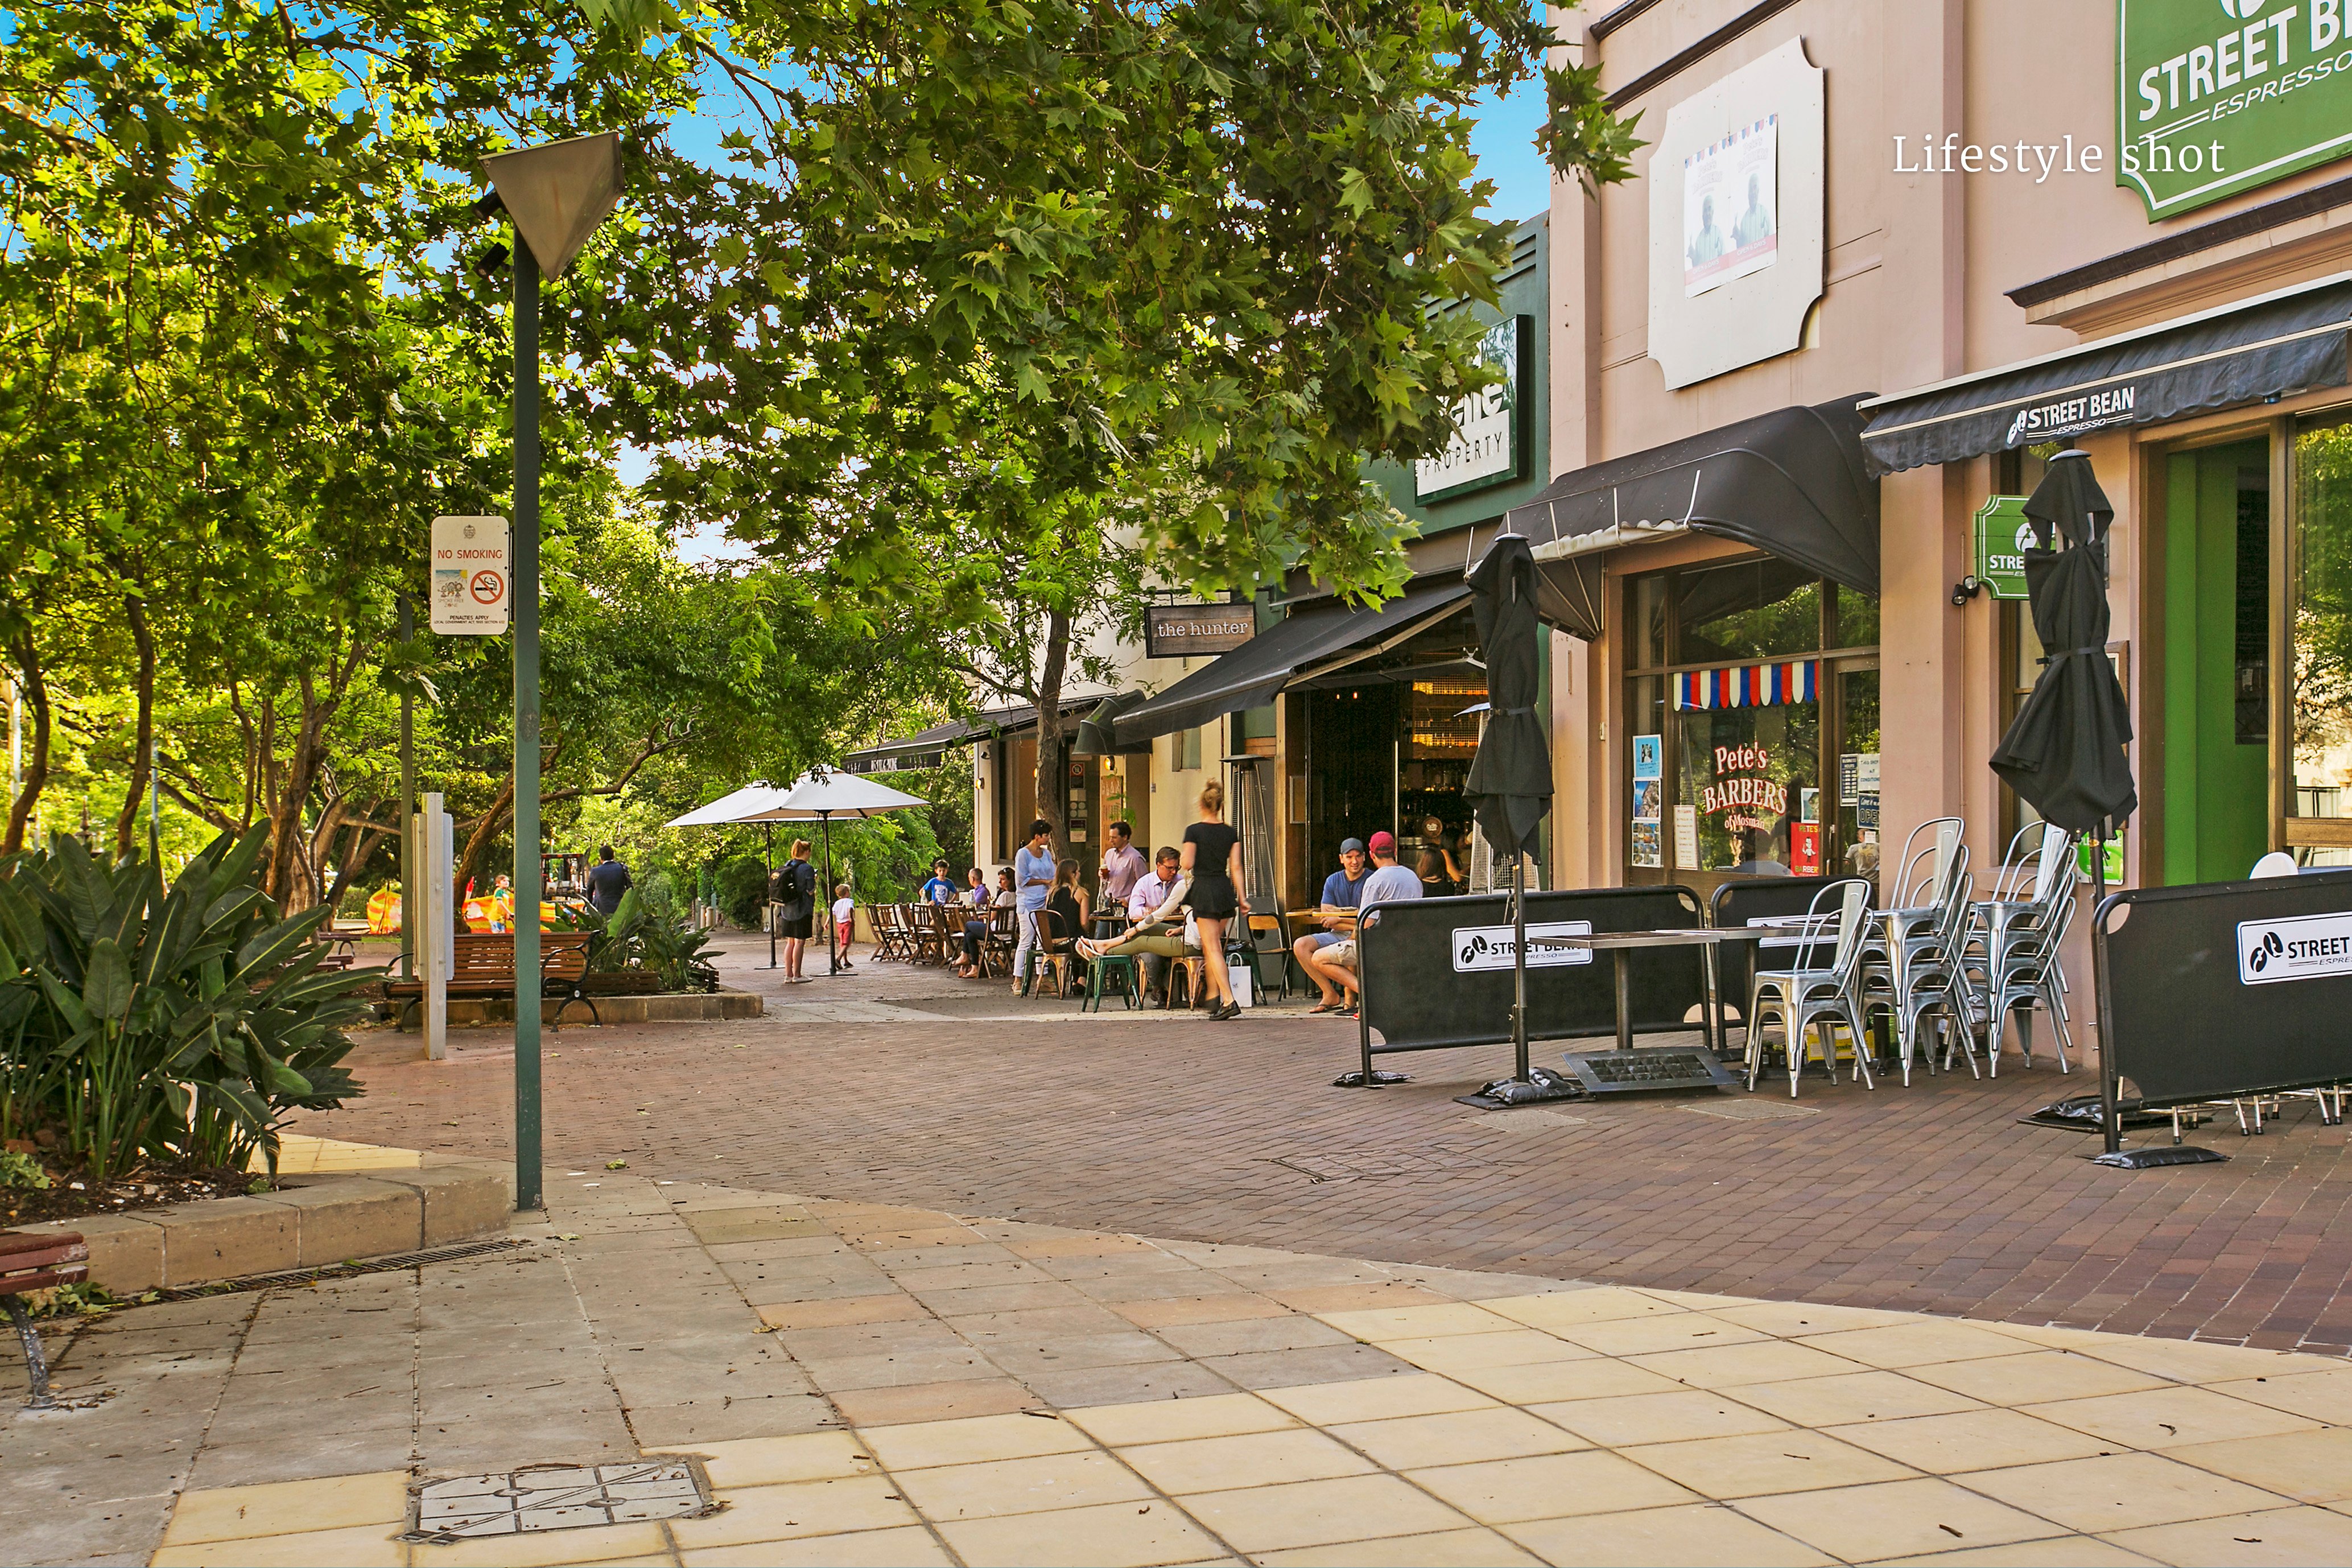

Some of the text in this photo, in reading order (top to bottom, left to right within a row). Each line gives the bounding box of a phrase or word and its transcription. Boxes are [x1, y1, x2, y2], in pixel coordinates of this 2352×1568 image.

[2138, 5, 2297, 121] STREET
[2211, 49, 2352, 121] ESPRESSO
[2027, 386, 2135, 429] STREET BEAN
[2056, 418, 2107, 435] ESPRESSO
[1425, 431, 1503, 476] PROPERTY
[438, 550, 502, 559] NO SMOKING
[1989, 555, 2025, 569] STRE
[1158, 621, 1248, 637] the hunter
[1714, 741, 1768, 775] Pete's
[1702, 777, 1788, 816] BARBERS
[1724, 813, 1765, 831] of Mosman
[1491, 940, 1540, 955] STRET
[2288, 936, 2350, 959] STREET
[2319, 956, 2352, 965] ESPRE
